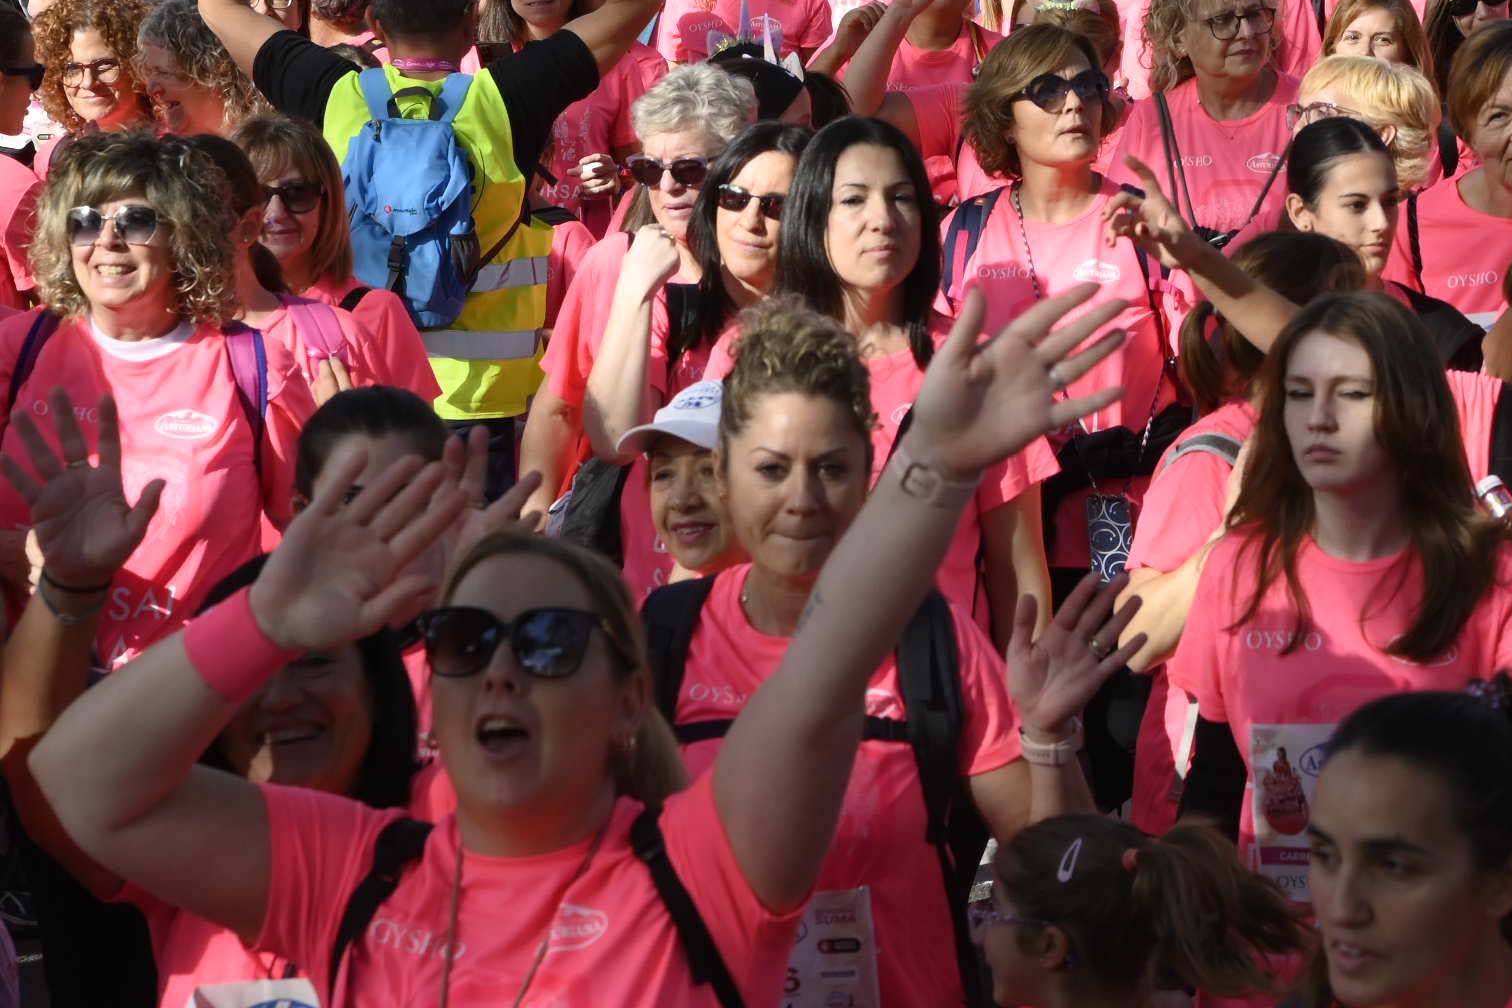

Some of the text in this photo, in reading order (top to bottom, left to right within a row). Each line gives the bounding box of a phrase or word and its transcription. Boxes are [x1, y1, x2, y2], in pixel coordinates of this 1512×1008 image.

[1447, 270, 1499, 289] OYSHO
[32, 399, 97, 423] OHO
[1246, 630, 1324, 652] OYSO
[1276, 875, 1310, 889] OYS
[369, 917, 467, 961] OYSHO
